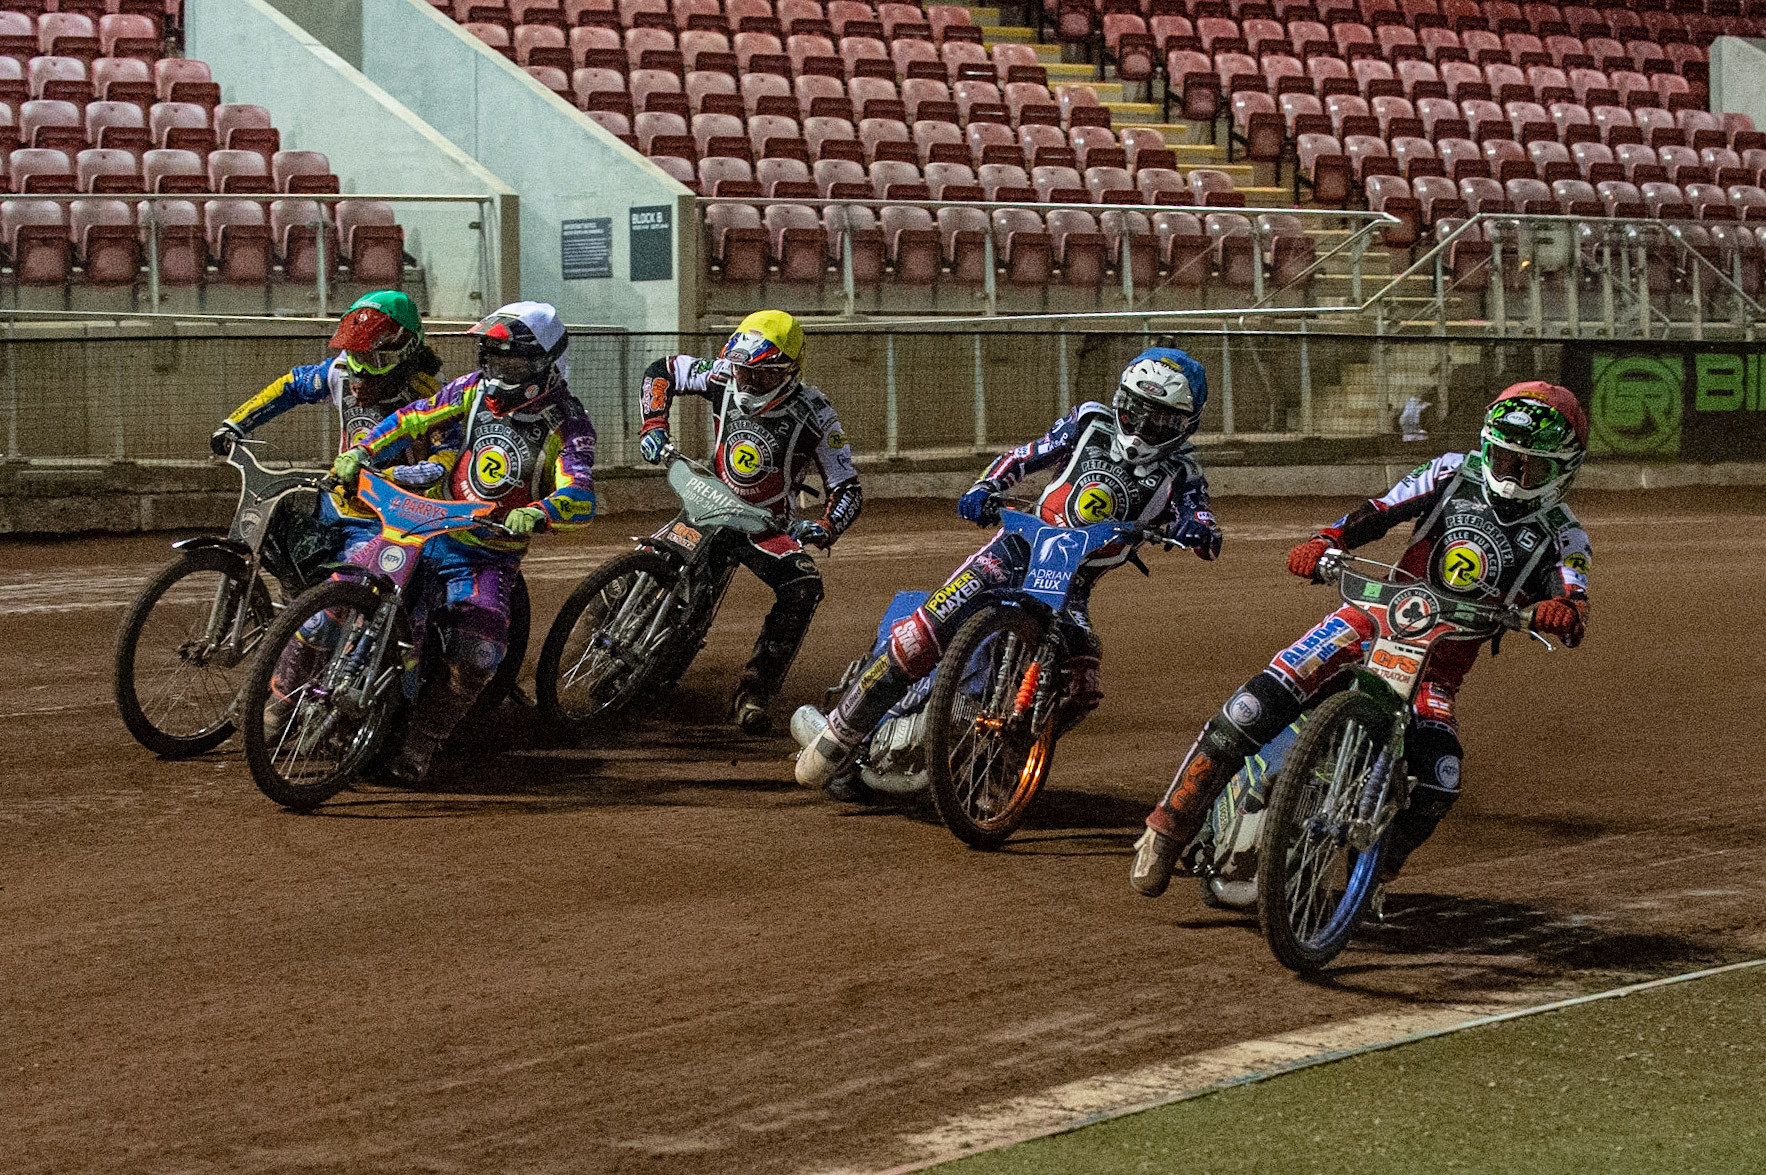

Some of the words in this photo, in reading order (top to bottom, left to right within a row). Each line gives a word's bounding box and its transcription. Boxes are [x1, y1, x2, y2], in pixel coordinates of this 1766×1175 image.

[632, 213, 655, 224] BLOCK
[475, 424, 504, 437] PETER
[504, 426, 530, 462] CRAVEN
[475, 439, 495, 451] BELLE
[497, 439, 510, 451] VUE
[509, 452, 518, 471] ACES
[729, 434, 745, 446] BELLE
[747, 434, 760, 444] VUE
[760, 445, 770, 461] ACES
[1081, 459, 1114, 472] PETER
[402, 498, 447, 519] PARRYS
[686, 477, 744, 516] PREMIER
[1079, 475, 1101, 487] BELLE
[1105, 476, 1119, 489] VUE
[1117, 493, 1126, 512] ACES
[1444, 532, 1469, 545] BELLE
[1473, 534, 1490, 550] VUE
[1488, 553, 1498, 577] ACES
[1446, 514, 1484, 528] PETER
[1482, 521, 1515, 567] CRAVEN
[1517, 529, 1538, 548] 15
[1028, 569, 1072, 580] ADRIAN
[1033, 578, 1061, 590] FLUX
[929, 571, 975, 612] POWER
[935, 579, 981, 619] MAXED
[1394, 589, 1411, 605] BELLE
[1414, 590, 1428, 599] VUE
[894, 621, 921, 658] STAR
[1281, 618, 1345, 664] ALBON
[1372, 649, 1419, 674] CFS
